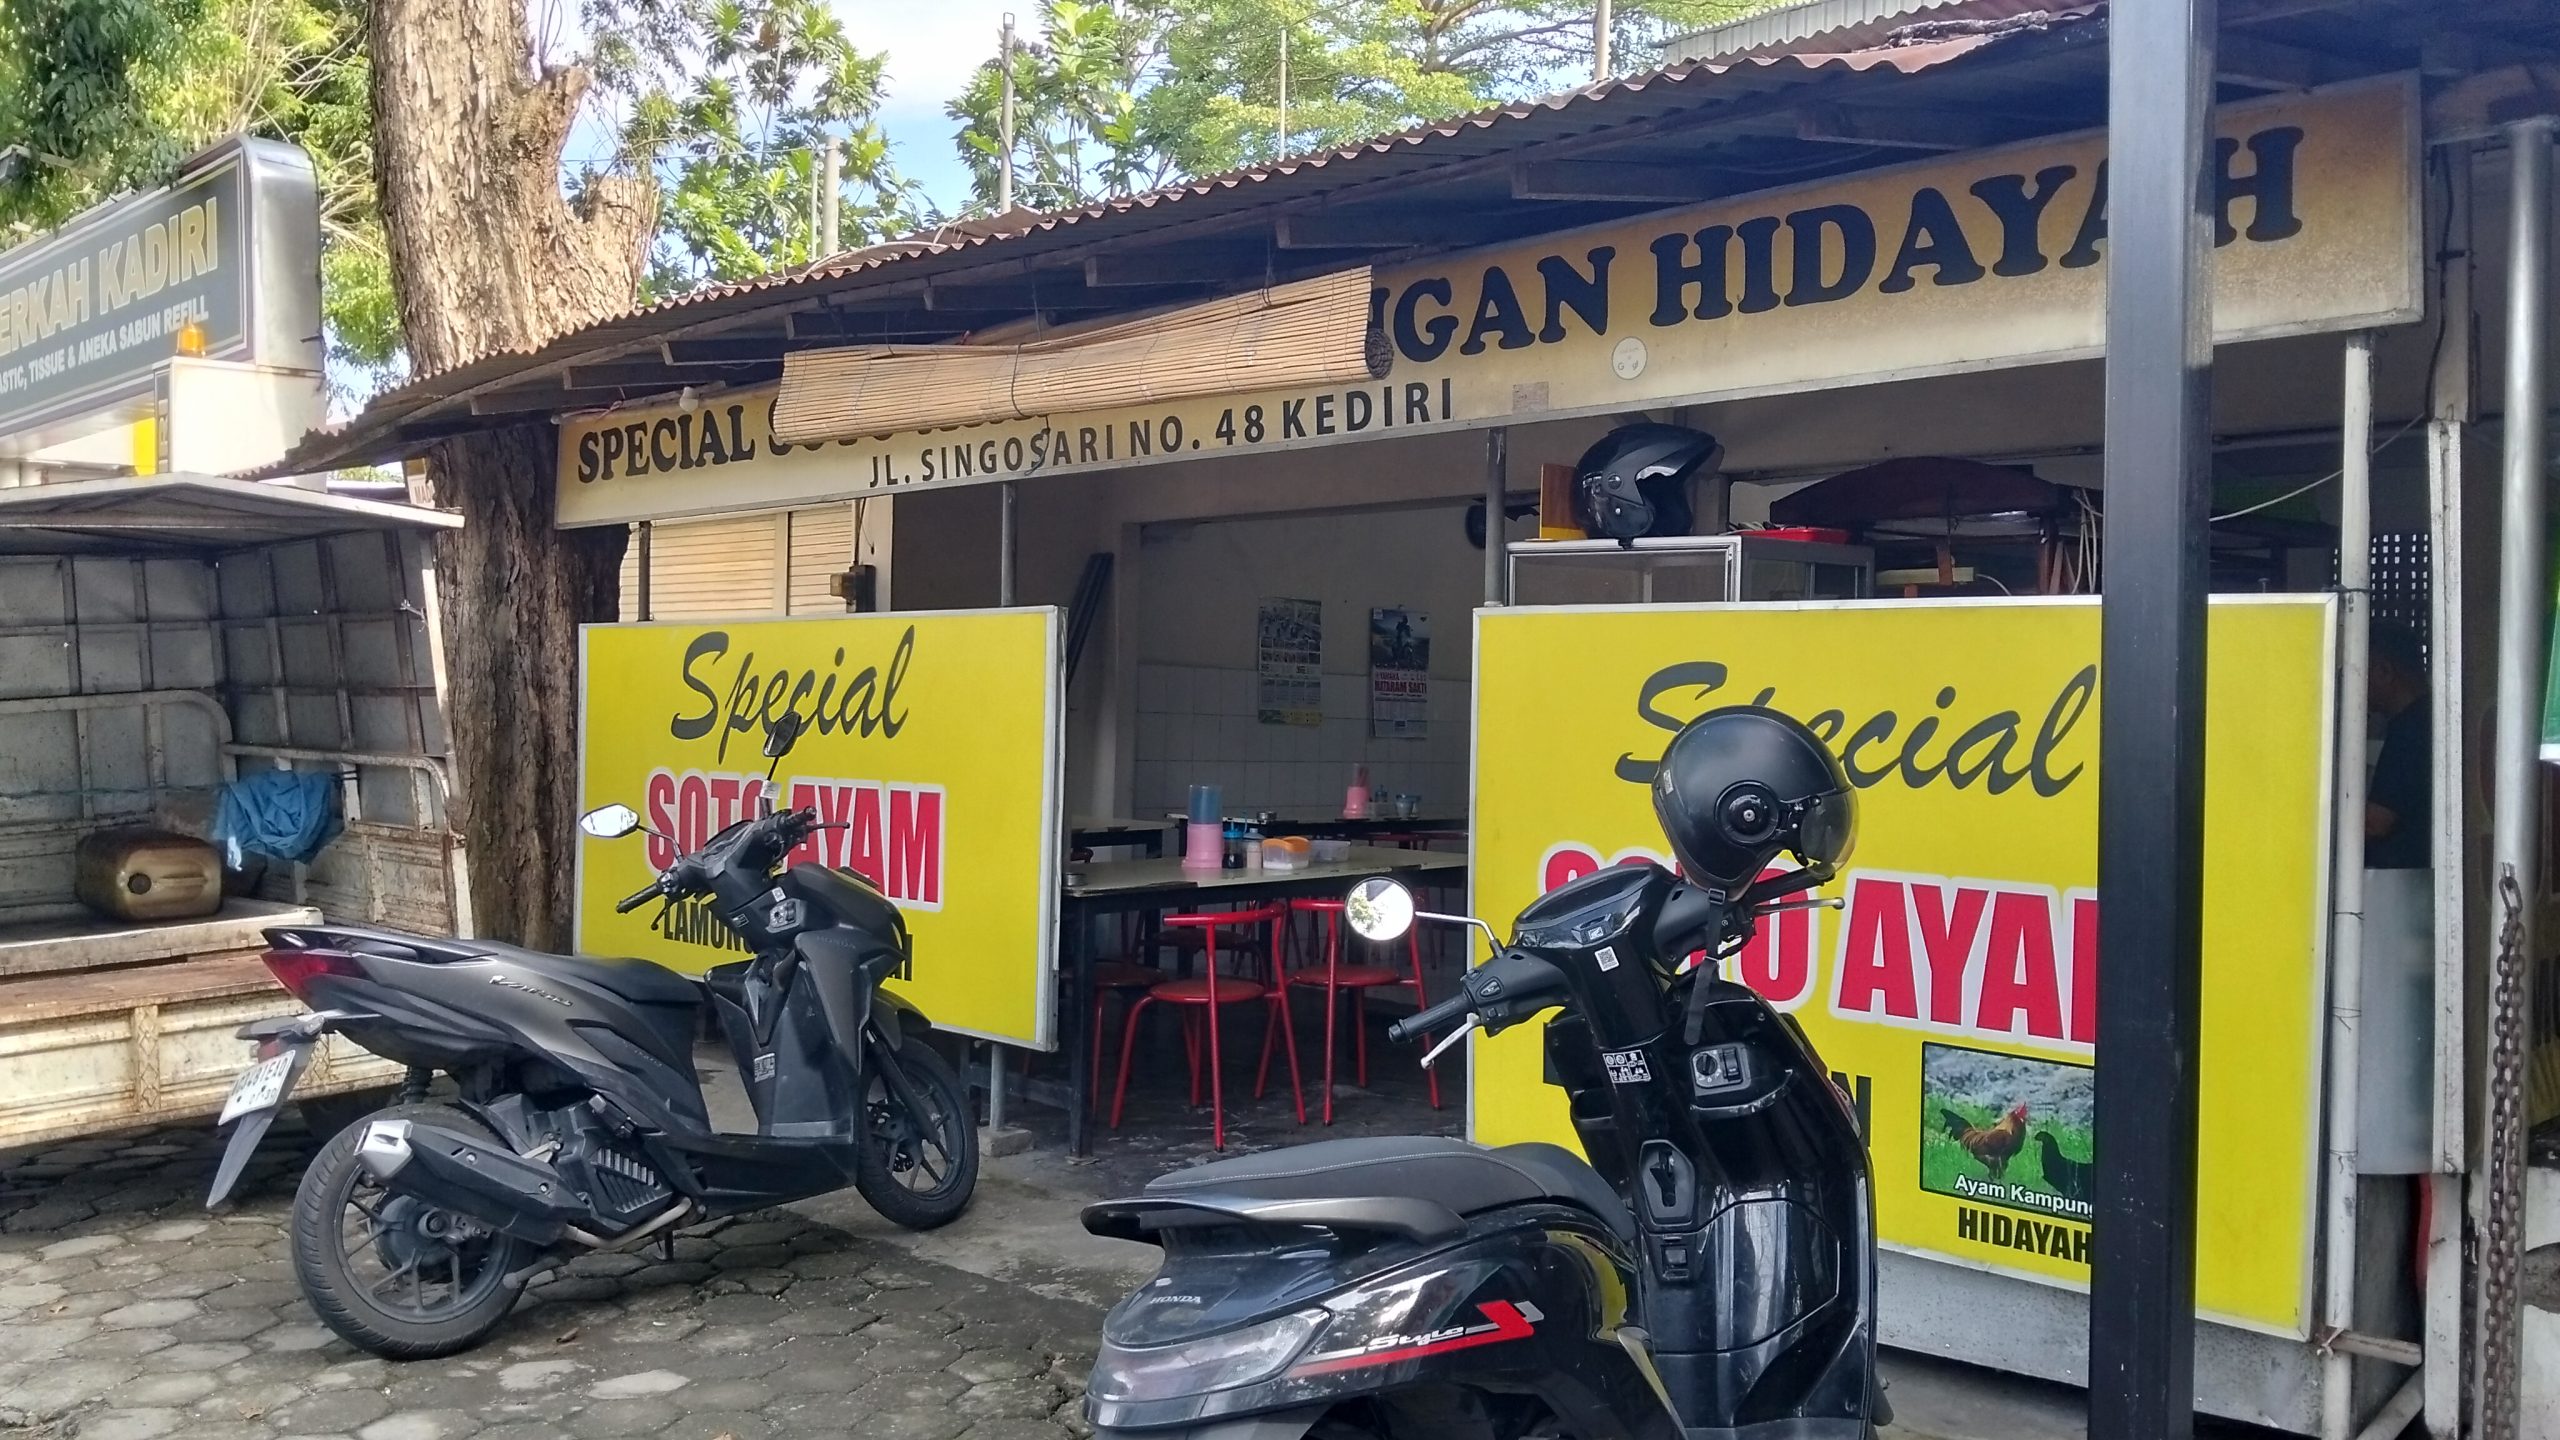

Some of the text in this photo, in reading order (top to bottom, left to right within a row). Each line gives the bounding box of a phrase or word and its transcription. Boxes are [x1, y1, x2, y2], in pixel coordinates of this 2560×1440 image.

[98, 196, 218, 315] KADIRI
[28, 346, 65, 383] TISSUE
[67, 347, 76, 369] &
[78, 330, 118, 366] ANEKA
[120, 312, 161, 349] SABUN
[164, 294, 209, 333] REFILL
[578, 404, 755, 484] SPECIAL
[869, 454, 911, 488] JL.
[921, 424, 1115, 482] SINGOSARI
[1129, 416, 1201, 456] NO.
[1215, 404, 1265, 446] 48
[1283, 377, 1452, 440] KEDIRI
[671, 624, 915, 765] Special
[1614, 660, 2098, 799] Secial
[1954, 1174, 2006, 1201] Ayam
[1958, 1205, 2092, 1265] HIDAYAH
